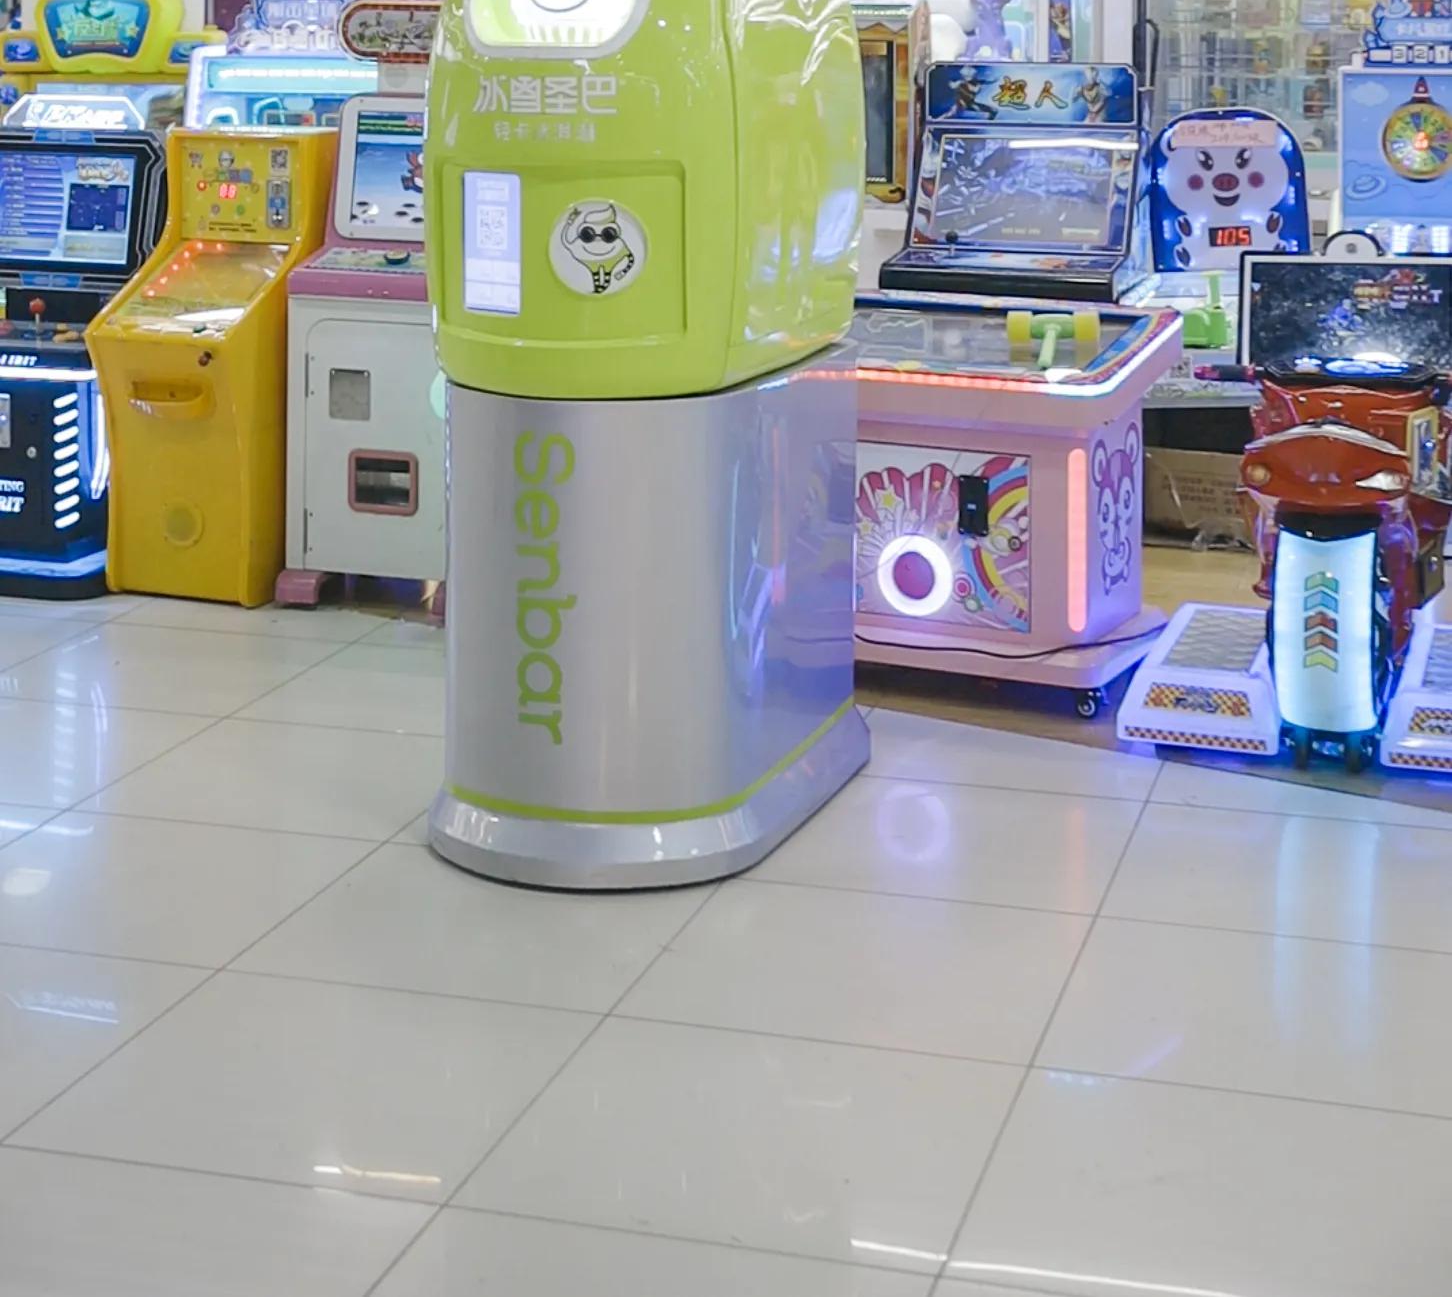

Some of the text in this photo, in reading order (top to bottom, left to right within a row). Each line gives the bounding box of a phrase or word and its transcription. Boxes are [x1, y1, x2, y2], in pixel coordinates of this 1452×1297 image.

[992, 75, 1069, 110] 超人
[1216, 228, 1250, 245] 105
[513, 430, 577, 746] Senbar
